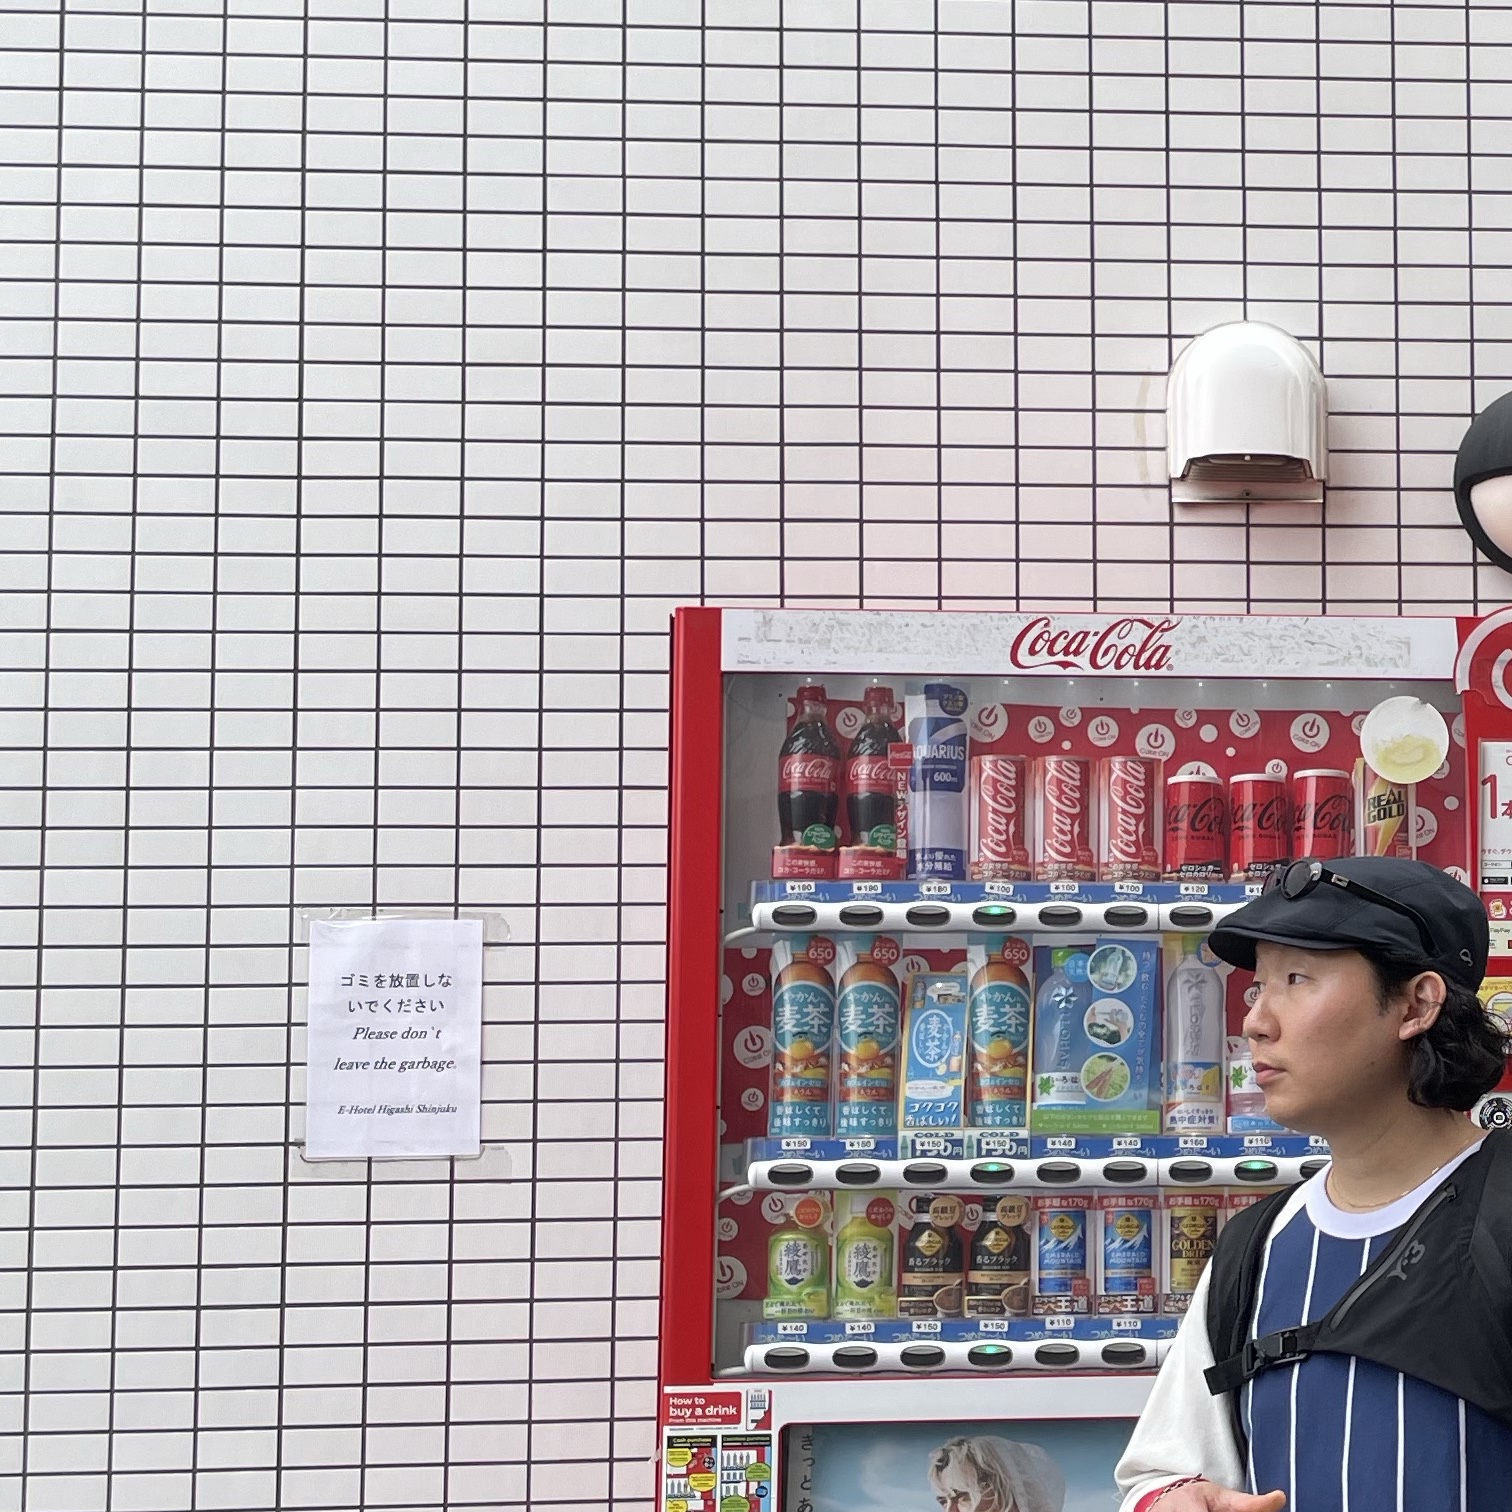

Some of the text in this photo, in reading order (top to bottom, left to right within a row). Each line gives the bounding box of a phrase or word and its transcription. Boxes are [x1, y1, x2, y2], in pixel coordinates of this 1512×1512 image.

[1010, 617, 1184, 671] Coca-Cola
[1367, 788, 1405, 810] REAL
[1109, 759, 1146, 862] Coca-Cola
[1367, 804, 1406, 824] GOLD
[917, 862, 953, 872] 水分補給
[1118, 883, 1140, 893] ¥100
[808, 948, 834, 960] 650
[873, 948, 898, 960] 650
[1003, 948, 1028, 960] 650
[340, 972, 453, 989] ゴミを放置しな
[348, 998, 444, 1013] いでください
[774, 1003, 832, 1034] 麦茶
[840, 1003, 897, 1034] 麦茶
[972, 1003, 1028, 1034] 麦茶
[351, 1027, 398, 1040] Please
[333, 1057, 457, 1073] leave the garbage.
[337, 1104, 457, 1116] E-Hotel Higashi Shinjuku
[908, 1101, 959, 1113] ゴクゴク
[905, 1113, 956, 1127] 香ばしい!
[1169, 1114, 1219, 1125] 熱中症対策!
[914, 1131, 955, 1139] COLD
[979, 1131, 1020, 1139] COLD
[785, 1140, 808, 1148] ¥150
[1116, 1139, 1138, 1147] ¥140
[1171, 1240, 1215, 1251] GOLDEN
[783, 1240, 804, 1276] 綾鷹
[976, 1255, 1018, 1264] 香るブラック
[1182, 1250, 1205, 1258] DRIP
[853, 1243, 871, 1278] 綾鷹
[908, 1257, 951, 1267] 香るブラック
[1385, 1240, 1426, 1281] Y-3
[781, 1324, 804, 1332] ¥140
[1115, 1320, 1138, 1328] ¥110
[669, 1397, 705, 1406] How to
[669, 1405, 738, 1418] buy a drink
